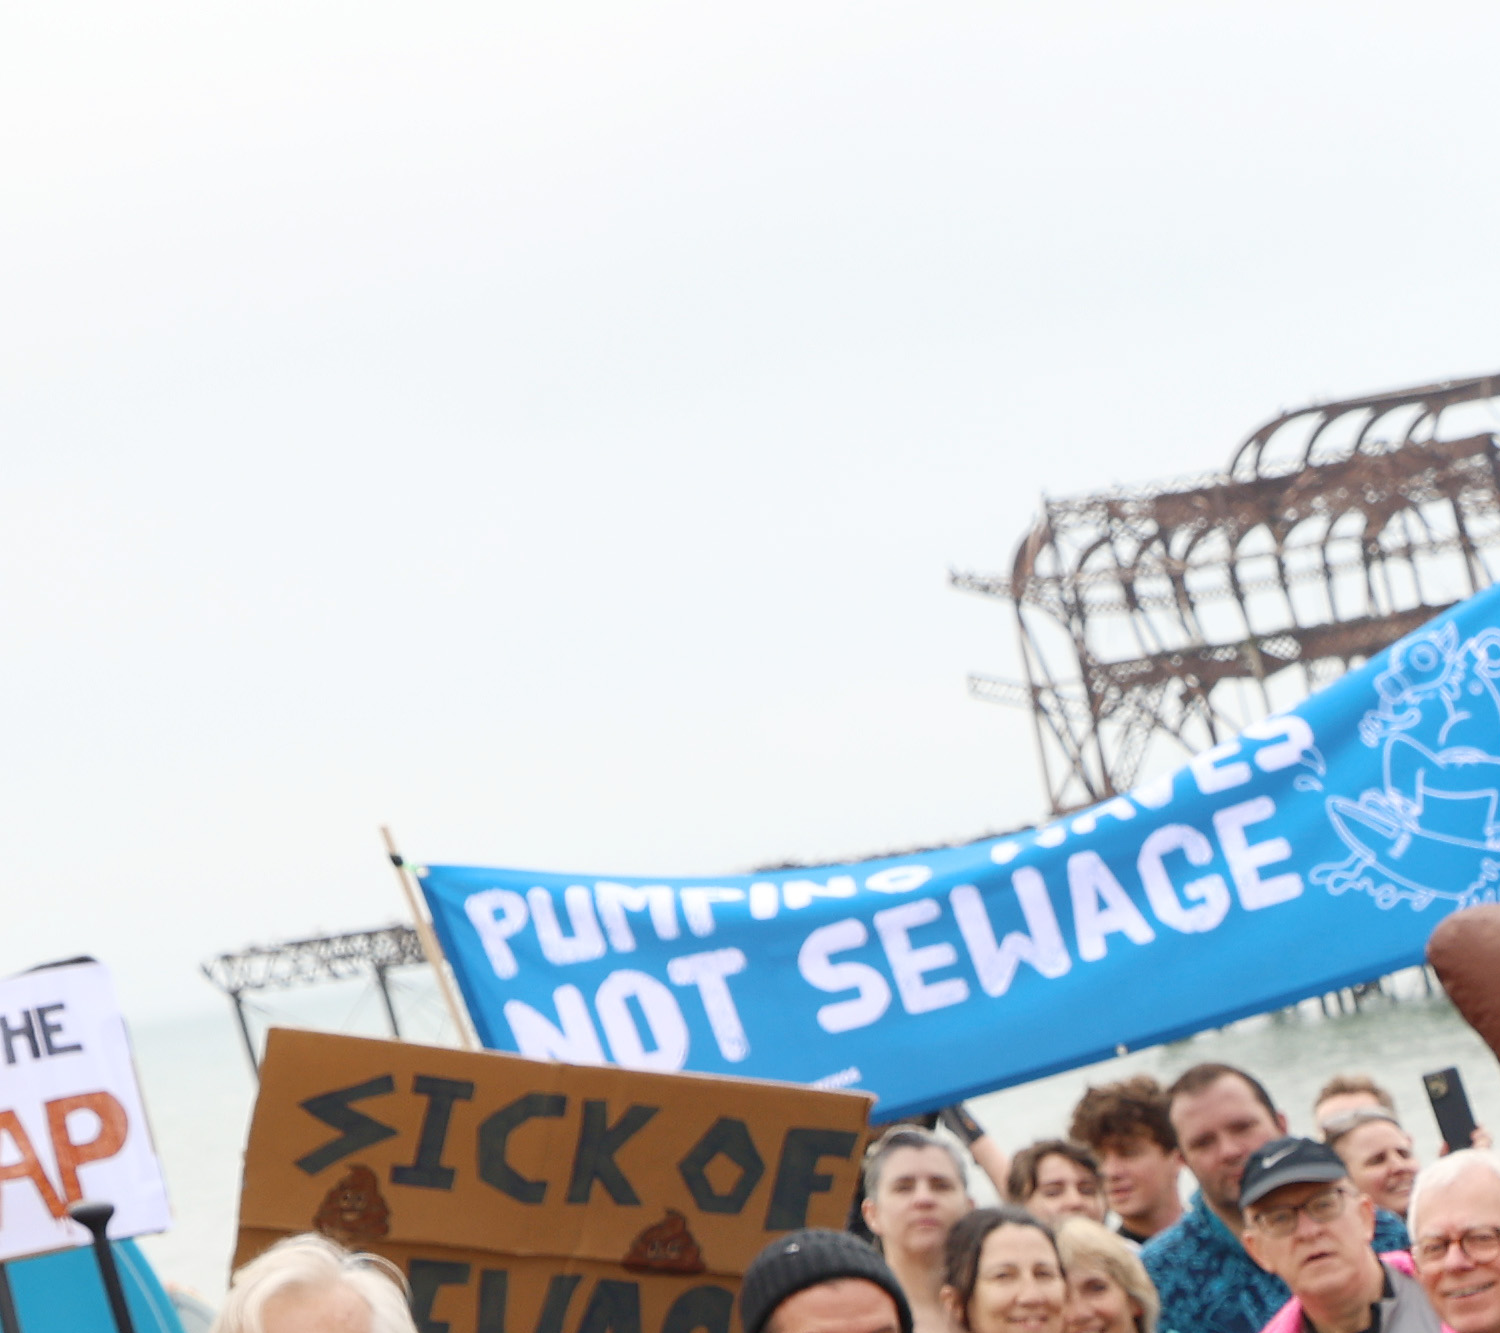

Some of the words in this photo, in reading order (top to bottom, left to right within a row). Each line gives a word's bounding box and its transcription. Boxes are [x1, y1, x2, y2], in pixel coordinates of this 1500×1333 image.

[503, 948, 747, 1074] NOT
[800, 795, 1305, 1032] SEWAGE
[294, 1072, 662, 1207] SICK
[676, 1114, 856, 1234] OF
